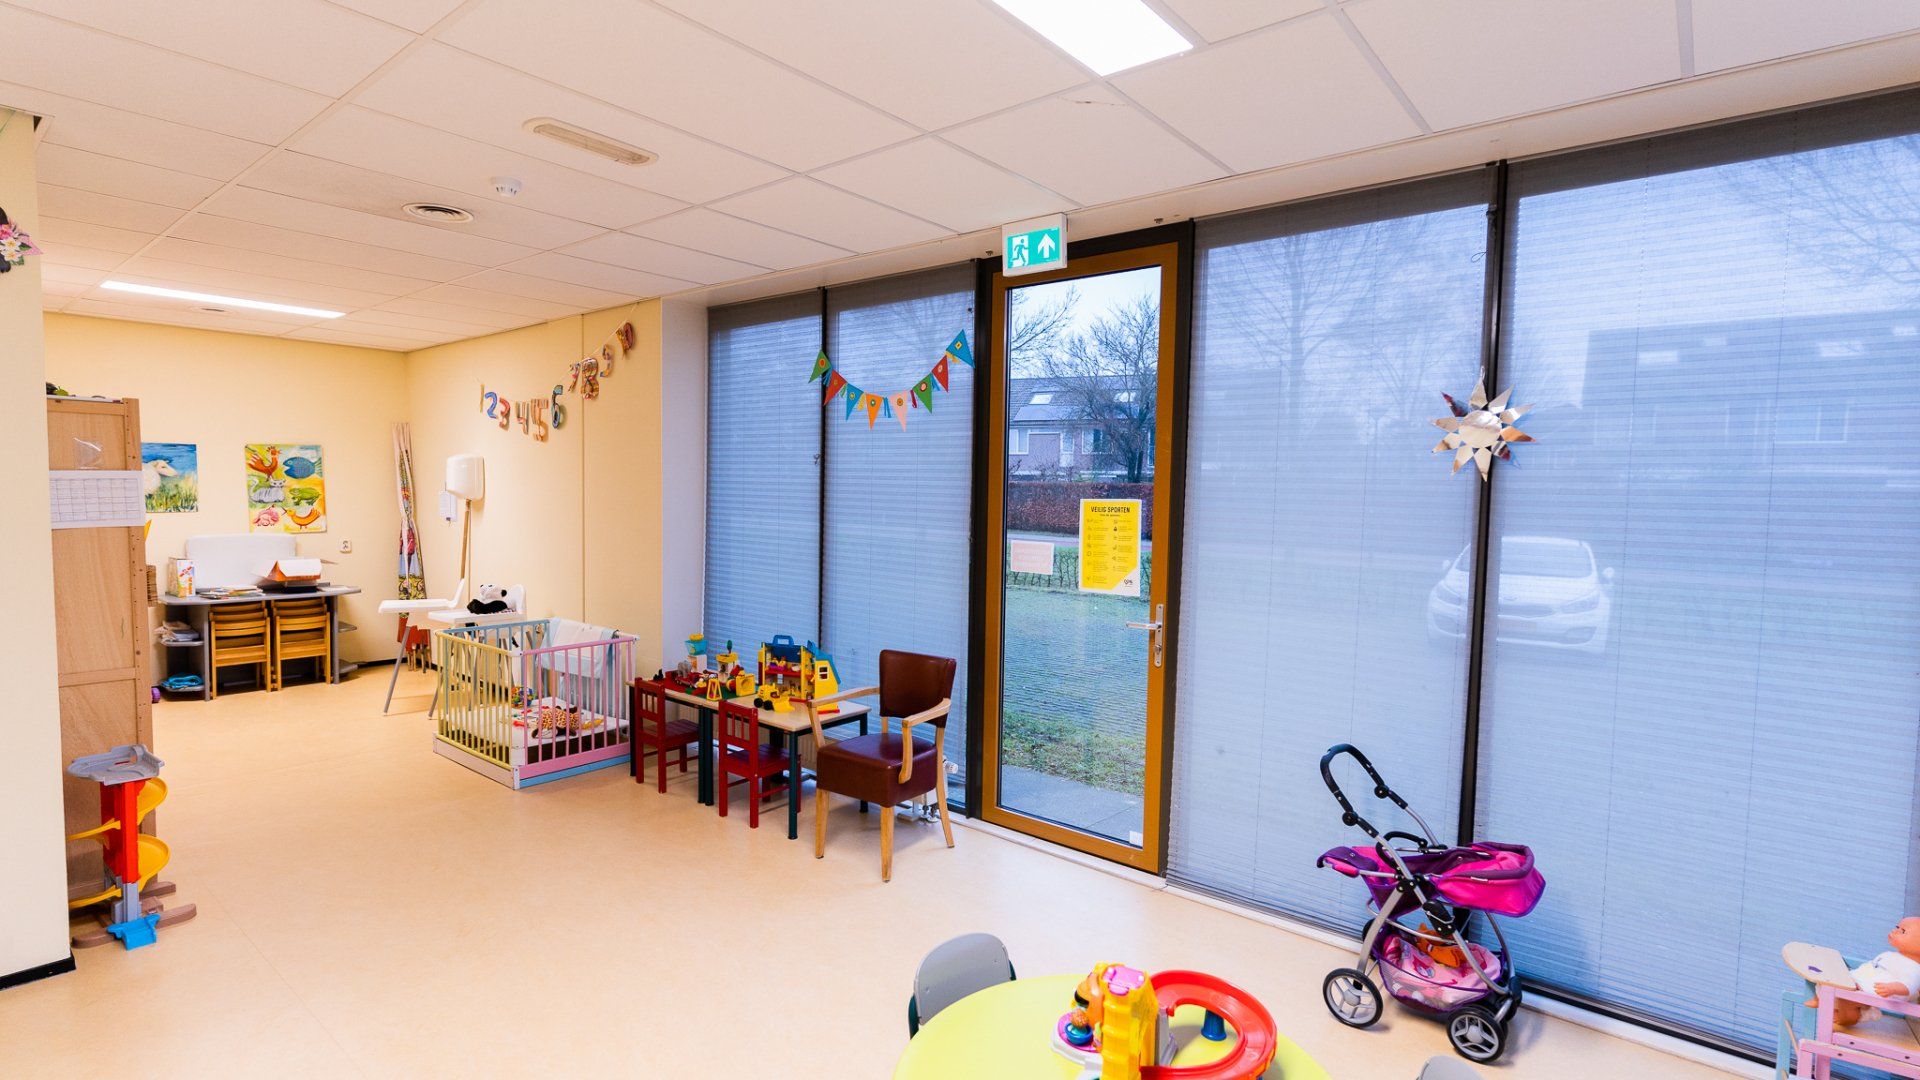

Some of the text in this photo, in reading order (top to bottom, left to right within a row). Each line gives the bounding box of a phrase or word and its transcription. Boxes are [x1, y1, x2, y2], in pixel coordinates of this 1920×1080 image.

[485, 392, 498, 419] 2
[499, 397, 511, 430] 3
[515, 401, 529, 435] 4
[551, 385, 564, 429] 6
[581, 358, 599, 400] 8
